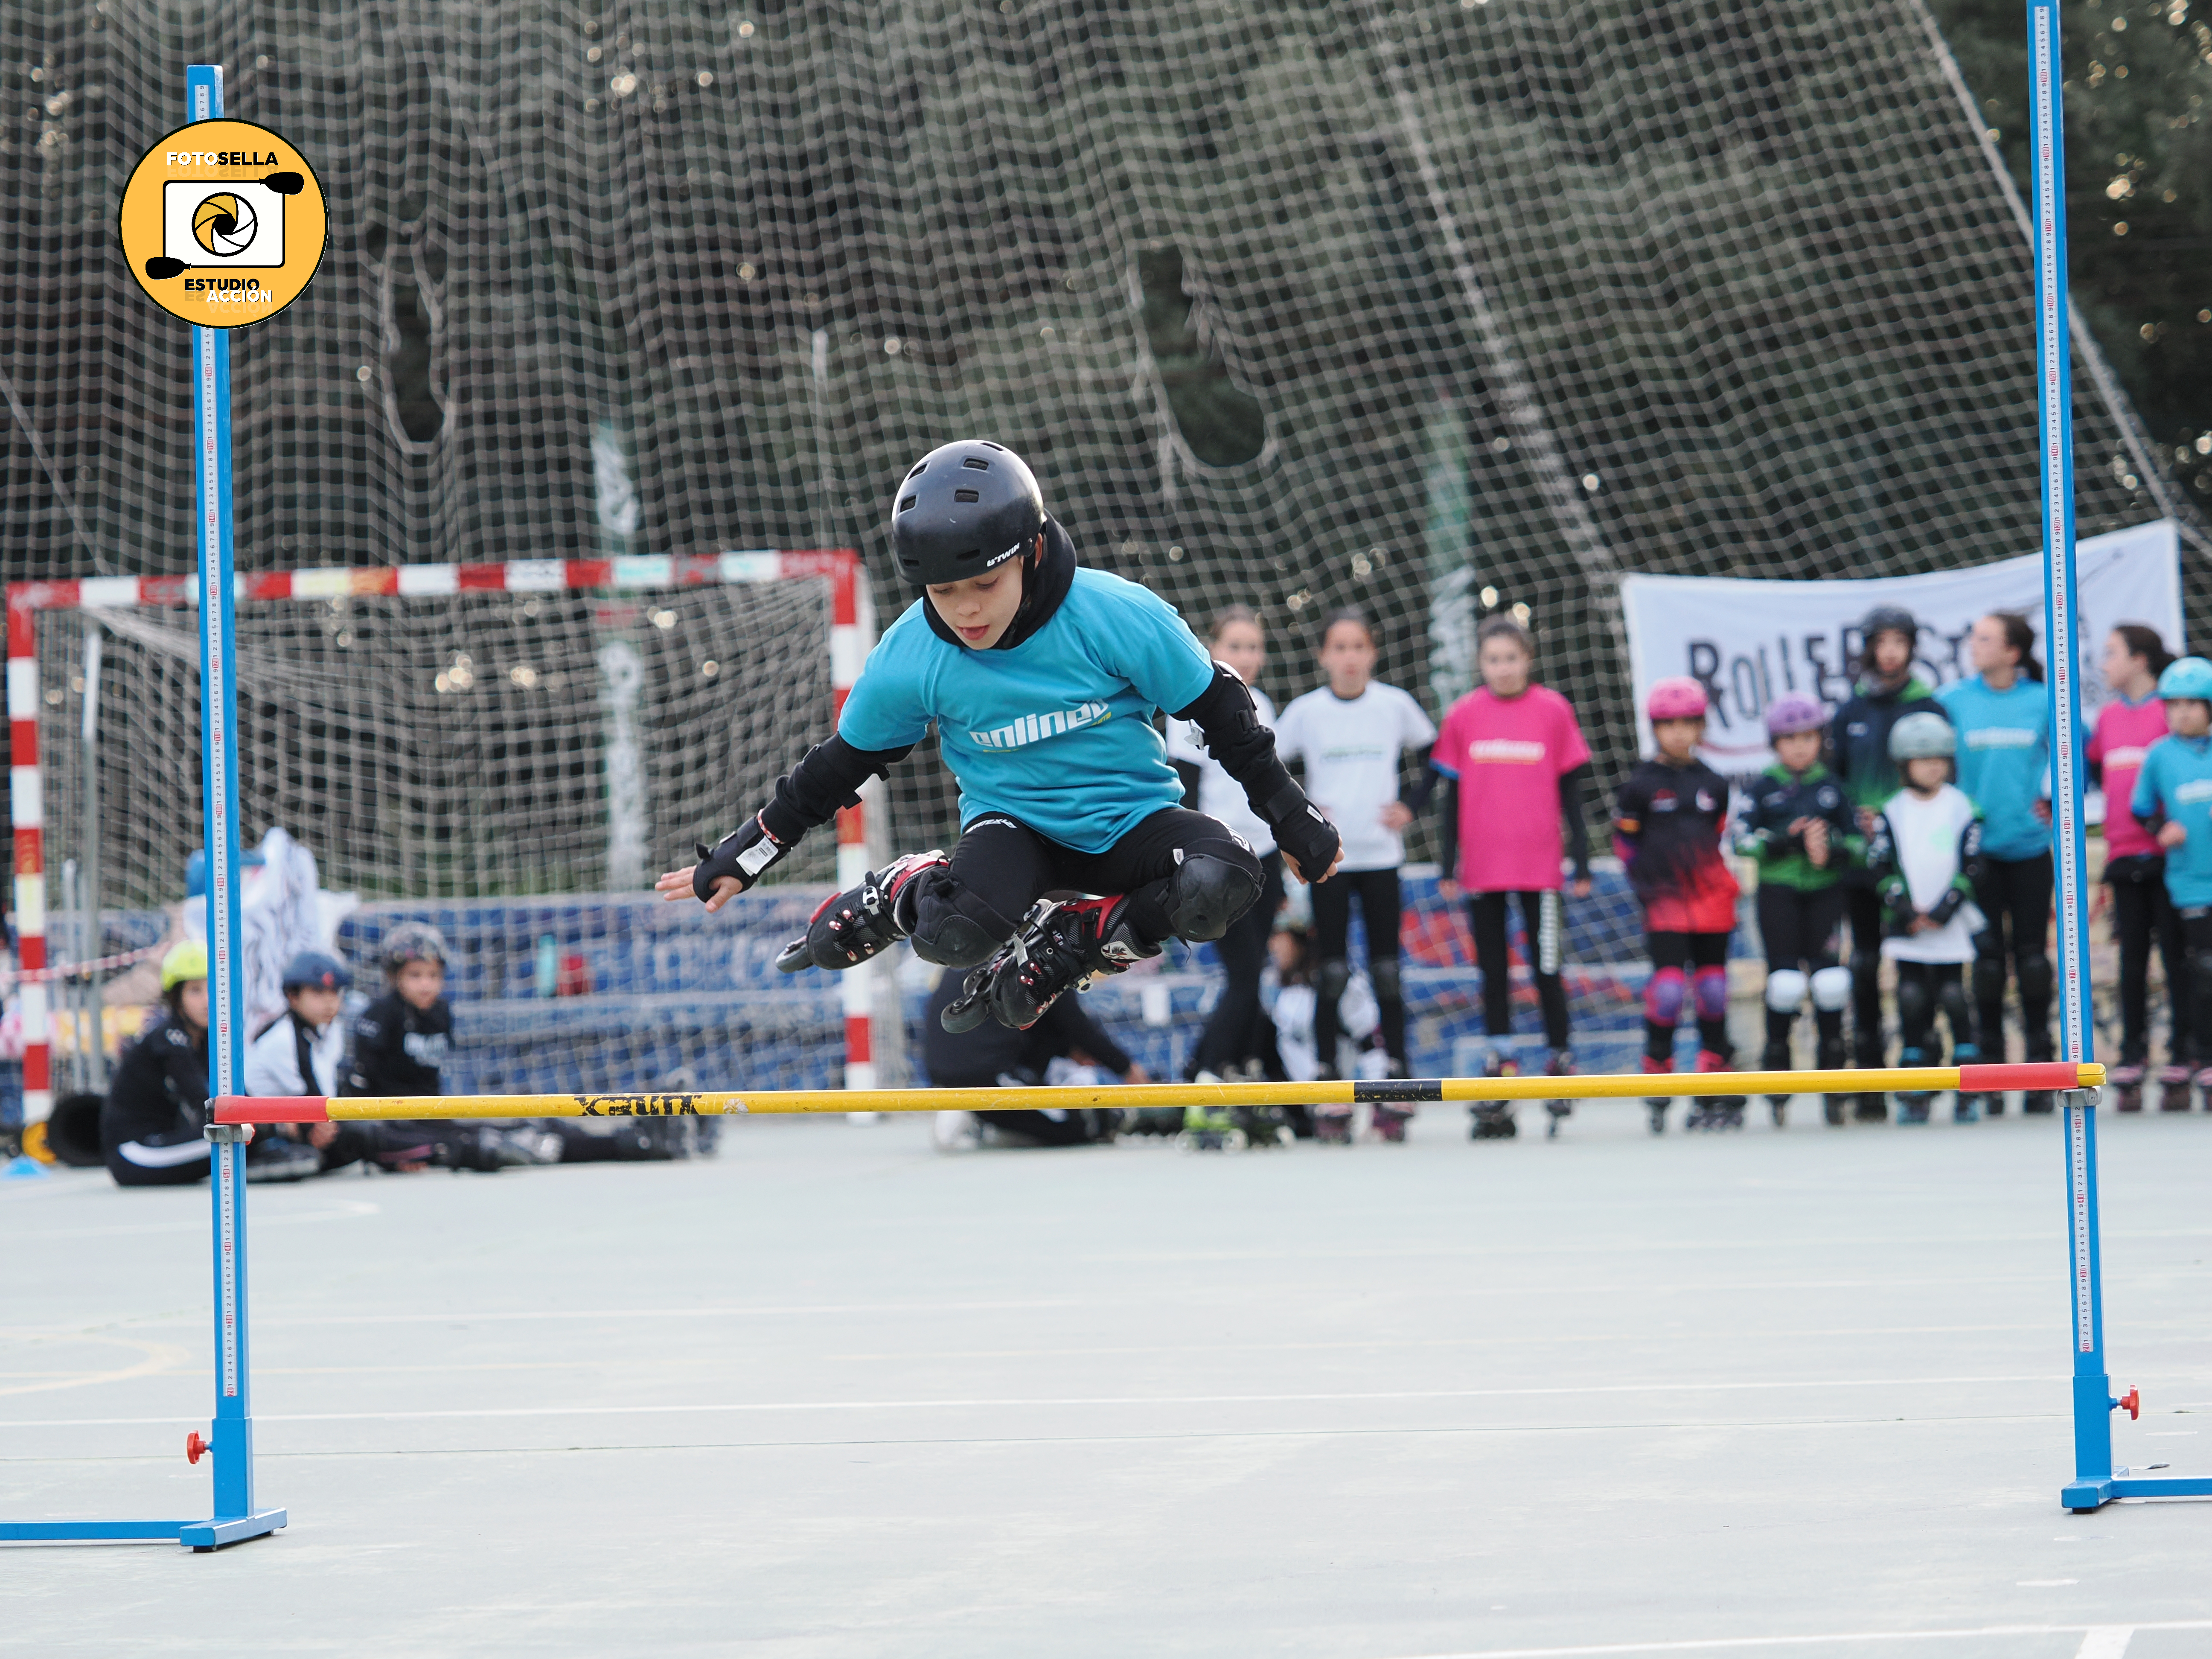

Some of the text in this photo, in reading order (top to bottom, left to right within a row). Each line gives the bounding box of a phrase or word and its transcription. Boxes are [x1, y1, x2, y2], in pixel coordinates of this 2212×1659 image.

[2064, 820, 2070, 830] 90
[218, 877, 224, 887] 90
[2067, 895, 2073, 904] 80
[219, 950, 225, 960] 80
[2069, 969, 2076, 979] 70
[221, 1023, 227, 1033] 70
[2072, 1044, 2079, 1054] 60
[2075, 1119, 2081, 1129] 50
[224, 1169, 230, 1178] 50
[2078, 1194, 2084, 1203] 40
[224, 1242, 231, 1251] 40
[2080, 1269, 2087, 1278] 30
[226, 1315, 232, 1324] 30
